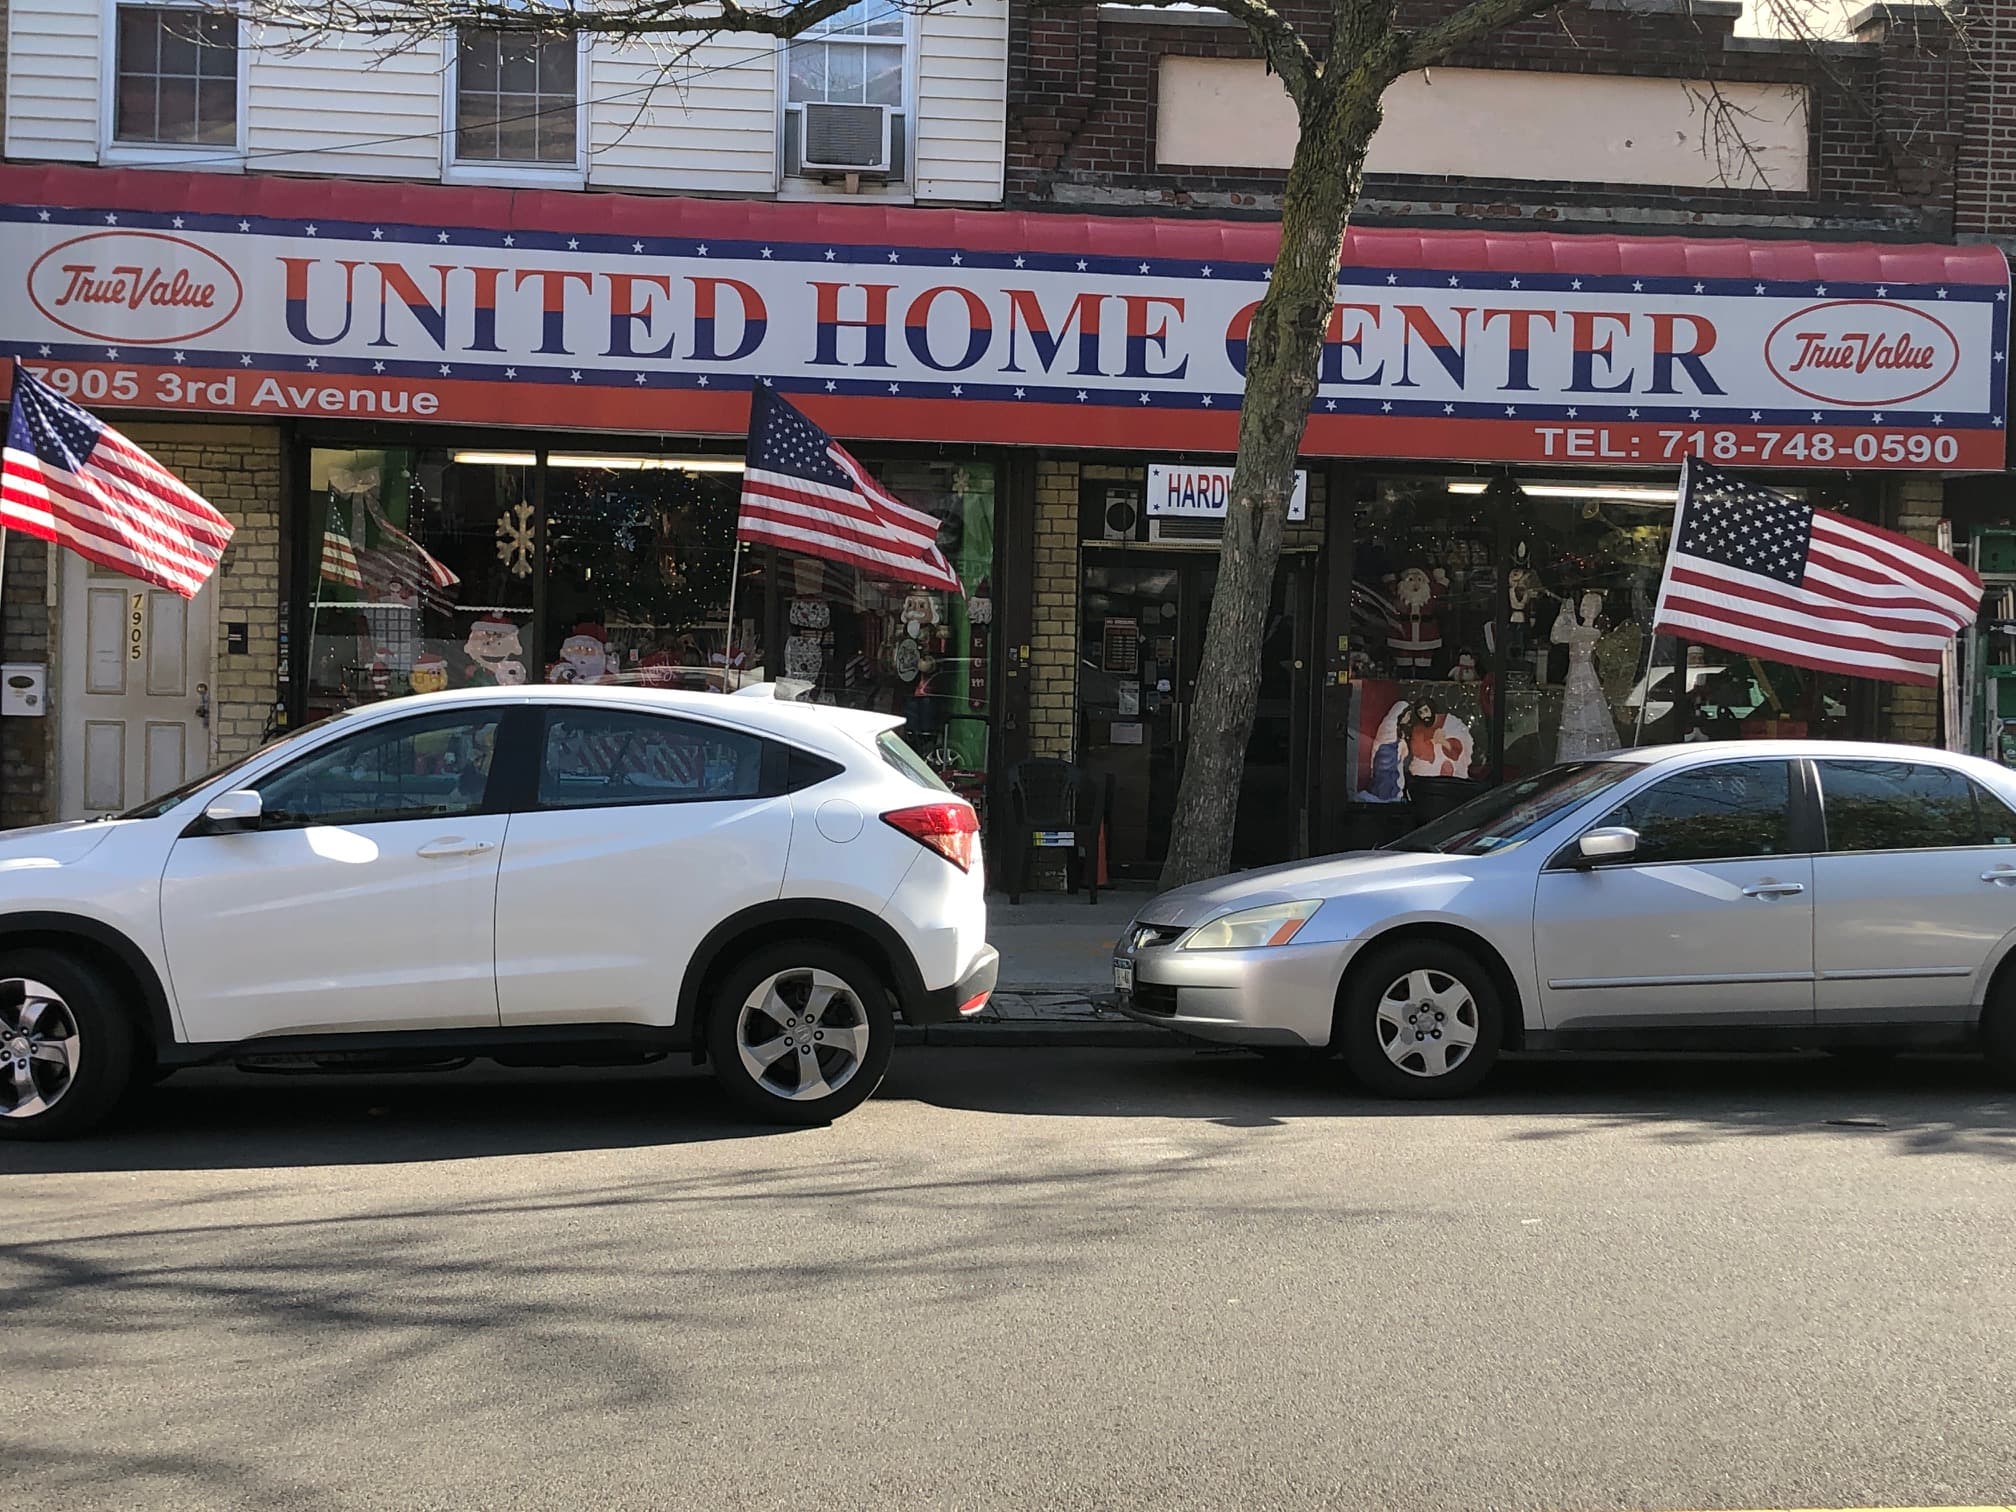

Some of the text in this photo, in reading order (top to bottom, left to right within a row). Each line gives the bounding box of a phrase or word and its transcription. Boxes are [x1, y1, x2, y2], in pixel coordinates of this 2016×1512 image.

[276, 257, 768, 361] UNITED
[804, 280, 1189, 381] HOME
[156, 372, 236, 405] 3rd
[250, 379, 440, 415] Avenue
[1534, 428, 1959, 464] TEL: 718-748-0590
[131, 594, 143, 660] 7905
